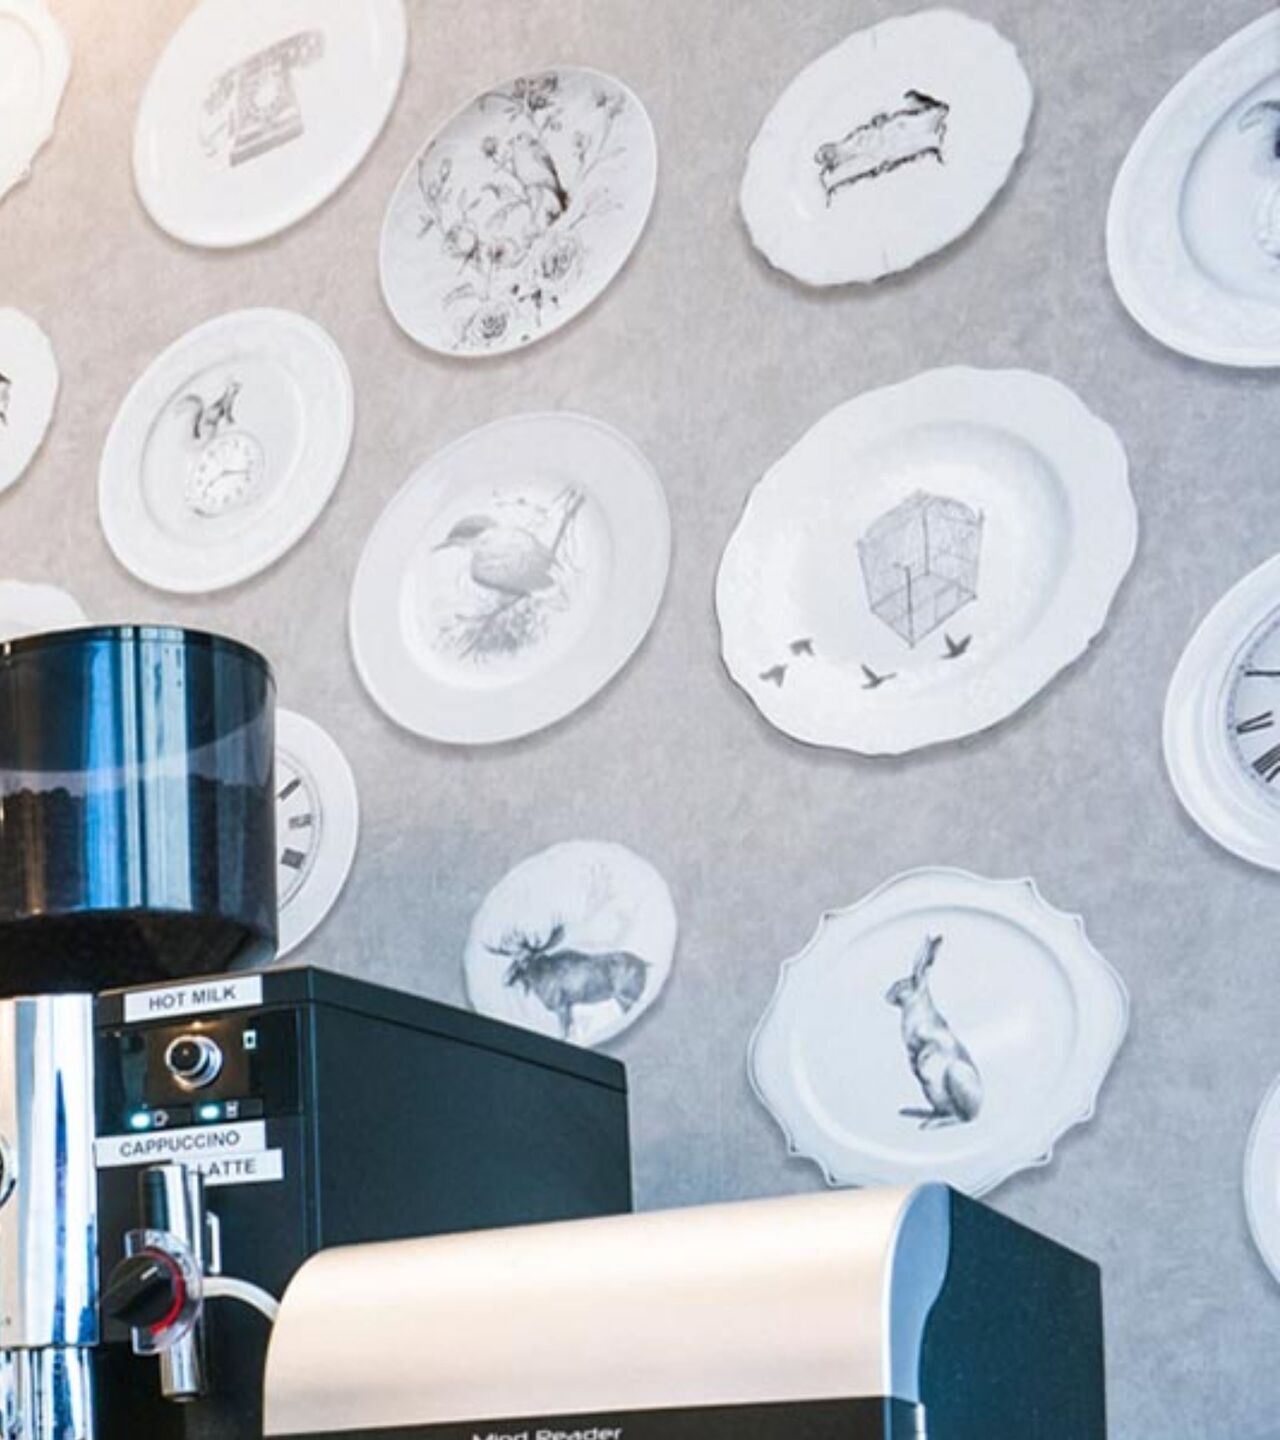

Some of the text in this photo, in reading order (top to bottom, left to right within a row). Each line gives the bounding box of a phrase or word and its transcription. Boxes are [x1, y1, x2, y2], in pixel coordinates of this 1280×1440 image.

[148, 986, 237, 1011] HOT MILK
[119, 1129, 241, 1158] CAPPUCCINO
